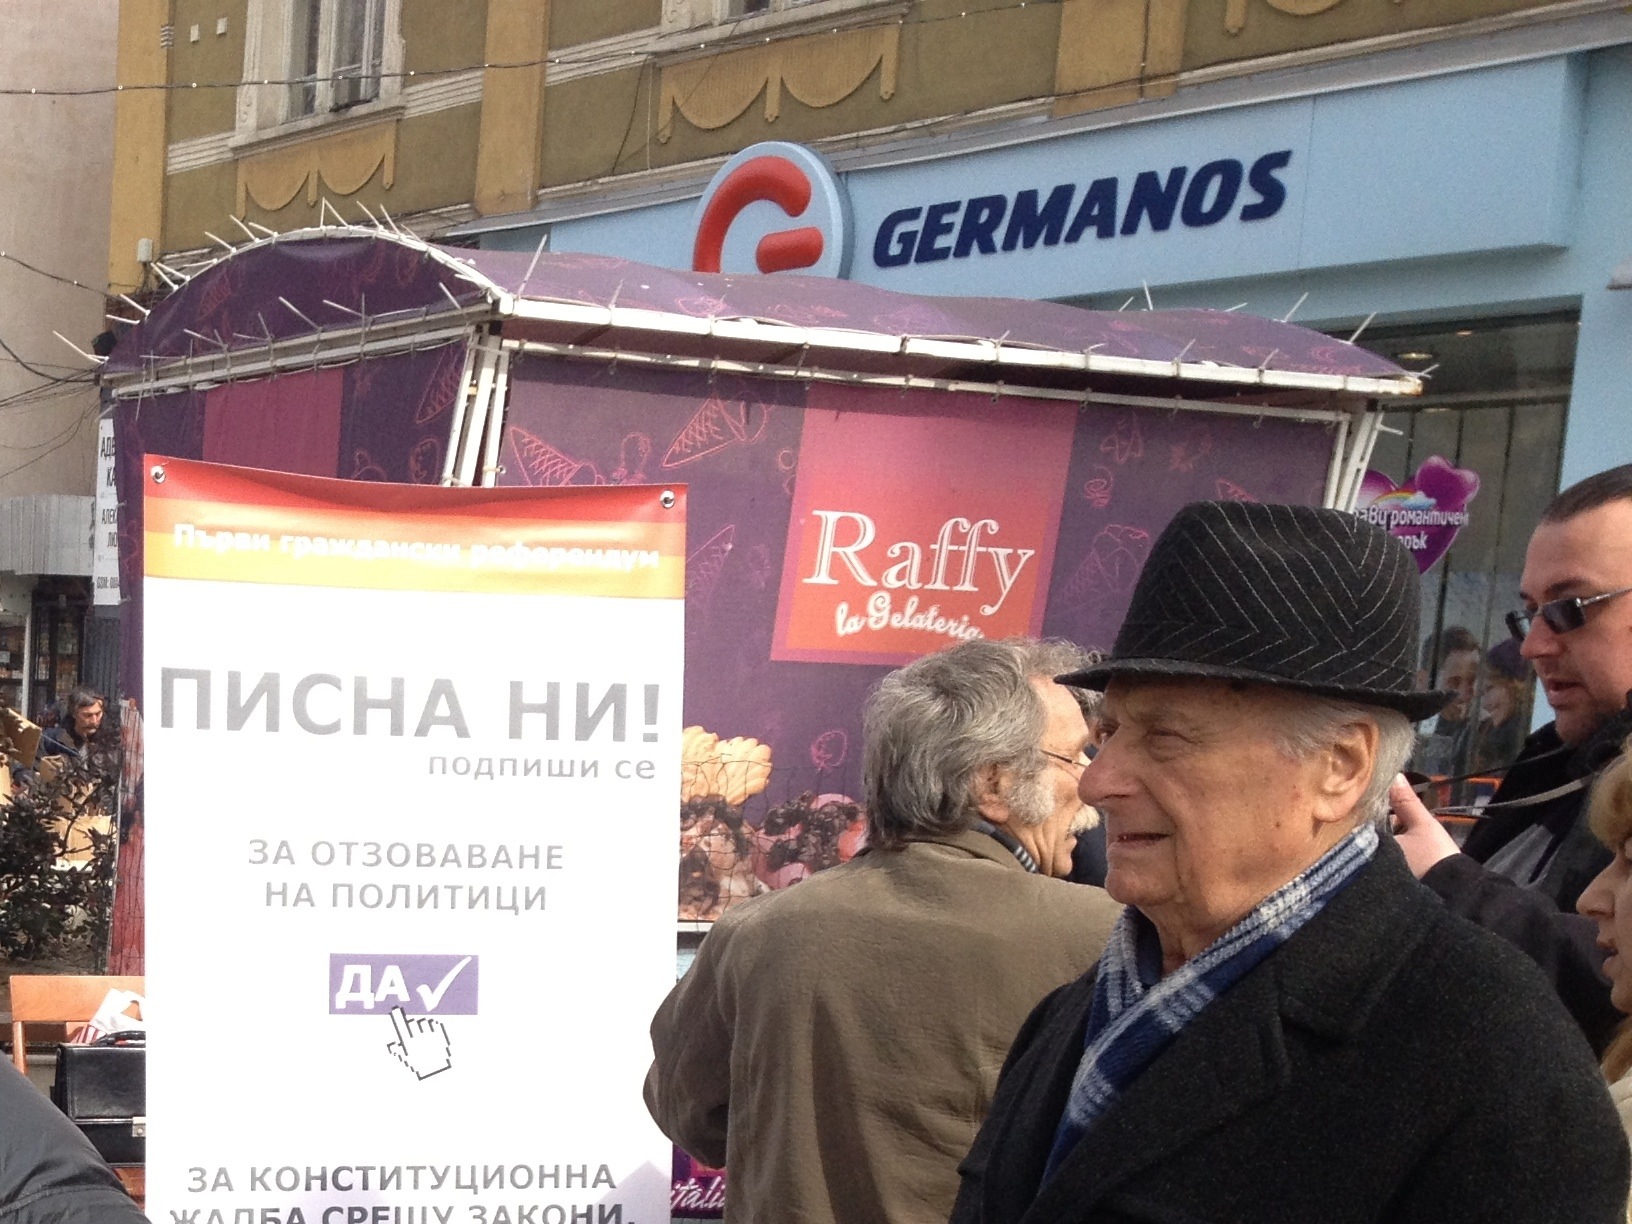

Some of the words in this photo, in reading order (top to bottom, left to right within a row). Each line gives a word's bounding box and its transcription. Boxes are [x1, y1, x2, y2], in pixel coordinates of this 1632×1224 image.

[873, 150, 1293, 268] GERMANOS
[174, 523, 269, 553] Първи
[280, 532, 460, 564] граждански
[471, 539, 660, 573] референдум
[802, 509, 1035, 616] Raffy
[836, 602, 865, 635] la
[866, 591, 985, 640] Gelateria
[160, 667, 470, 739] ПИСНА
[508, 681, 660, 743] НИ!
[428, 756, 599, 780] подпиши
[615, 758, 657, 779] се
[247, 839, 296, 867] ЗА
[310, 840, 565, 871] ОТЗОВАВАНЕ
[266, 881, 316, 909] НА
[331, 882, 547, 916] ПОЛИТИЦИ
[335, 964, 411, 1010] ДА
[188, 1166, 235, 1193] ЗА
[250, 1164, 618, 1195] КОНСТИТУЦИОННА
